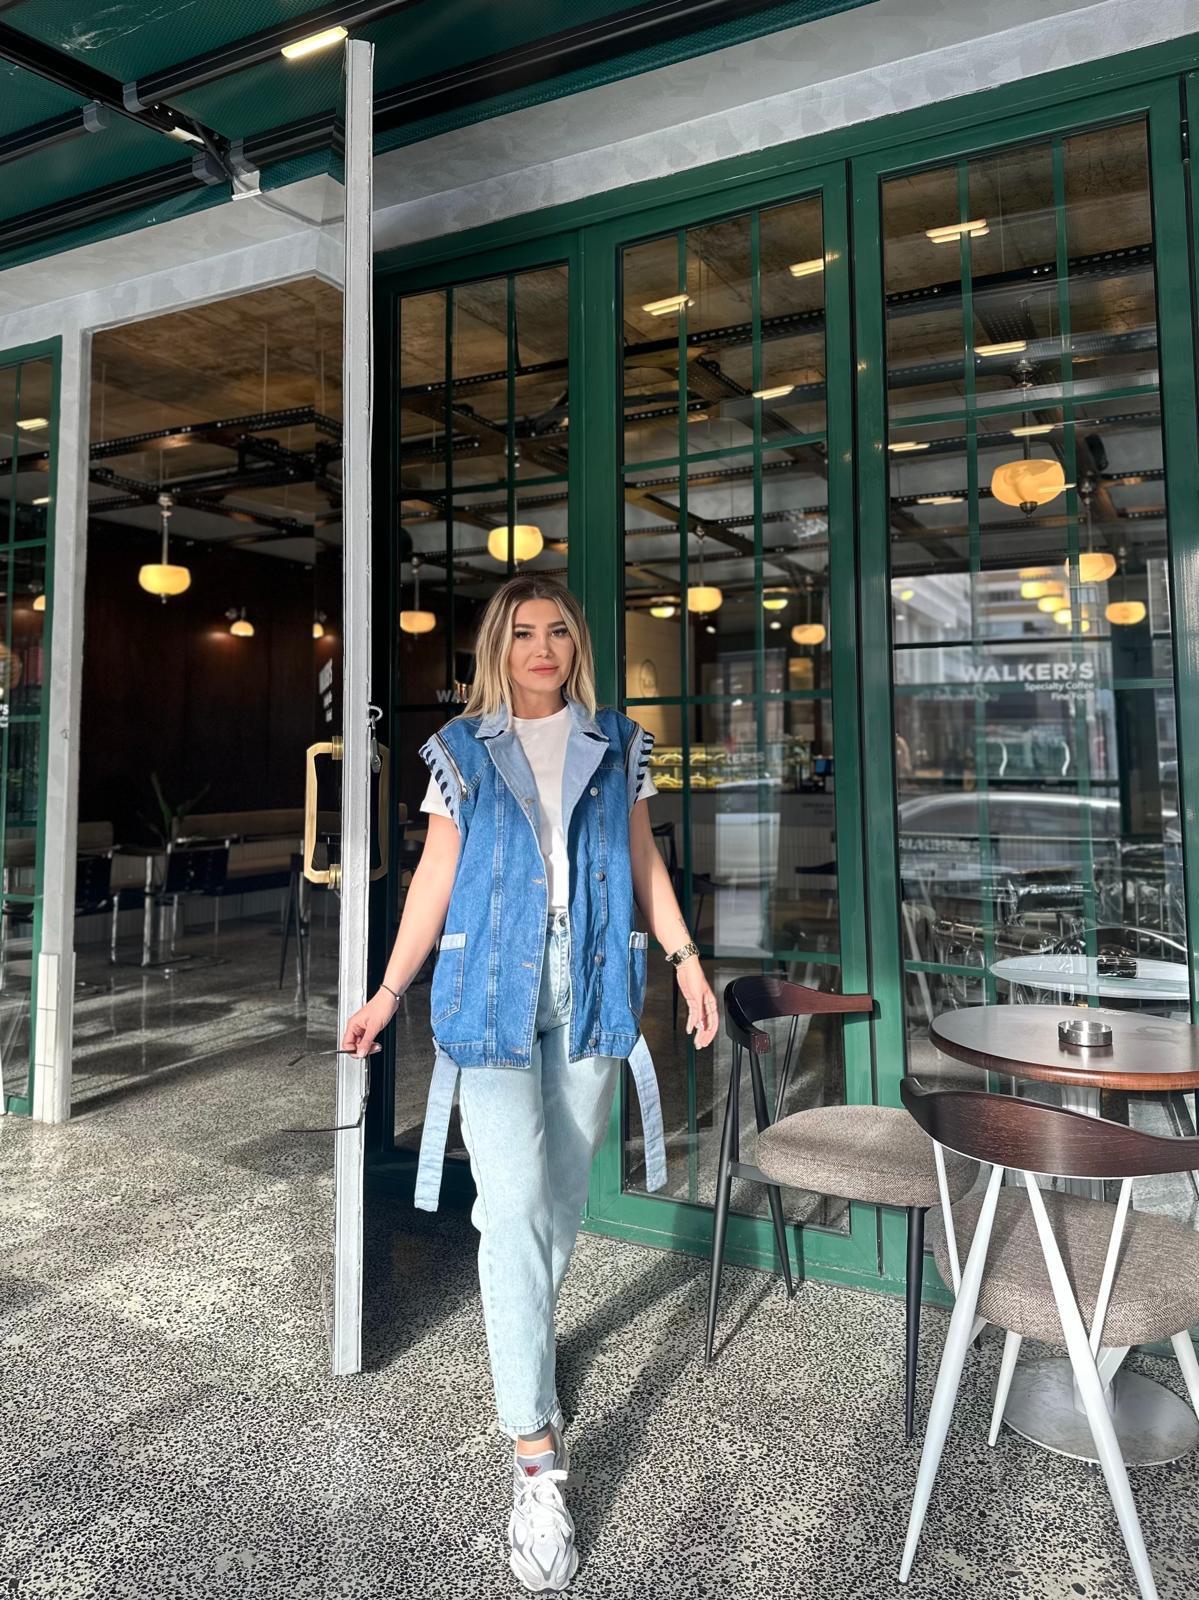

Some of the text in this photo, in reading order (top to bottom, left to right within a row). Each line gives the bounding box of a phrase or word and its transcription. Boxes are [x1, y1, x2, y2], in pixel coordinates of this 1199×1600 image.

[963, 662, 1094, 682] WALKER'S
[1023, 681, 1094, 692] Specialty Coffee
